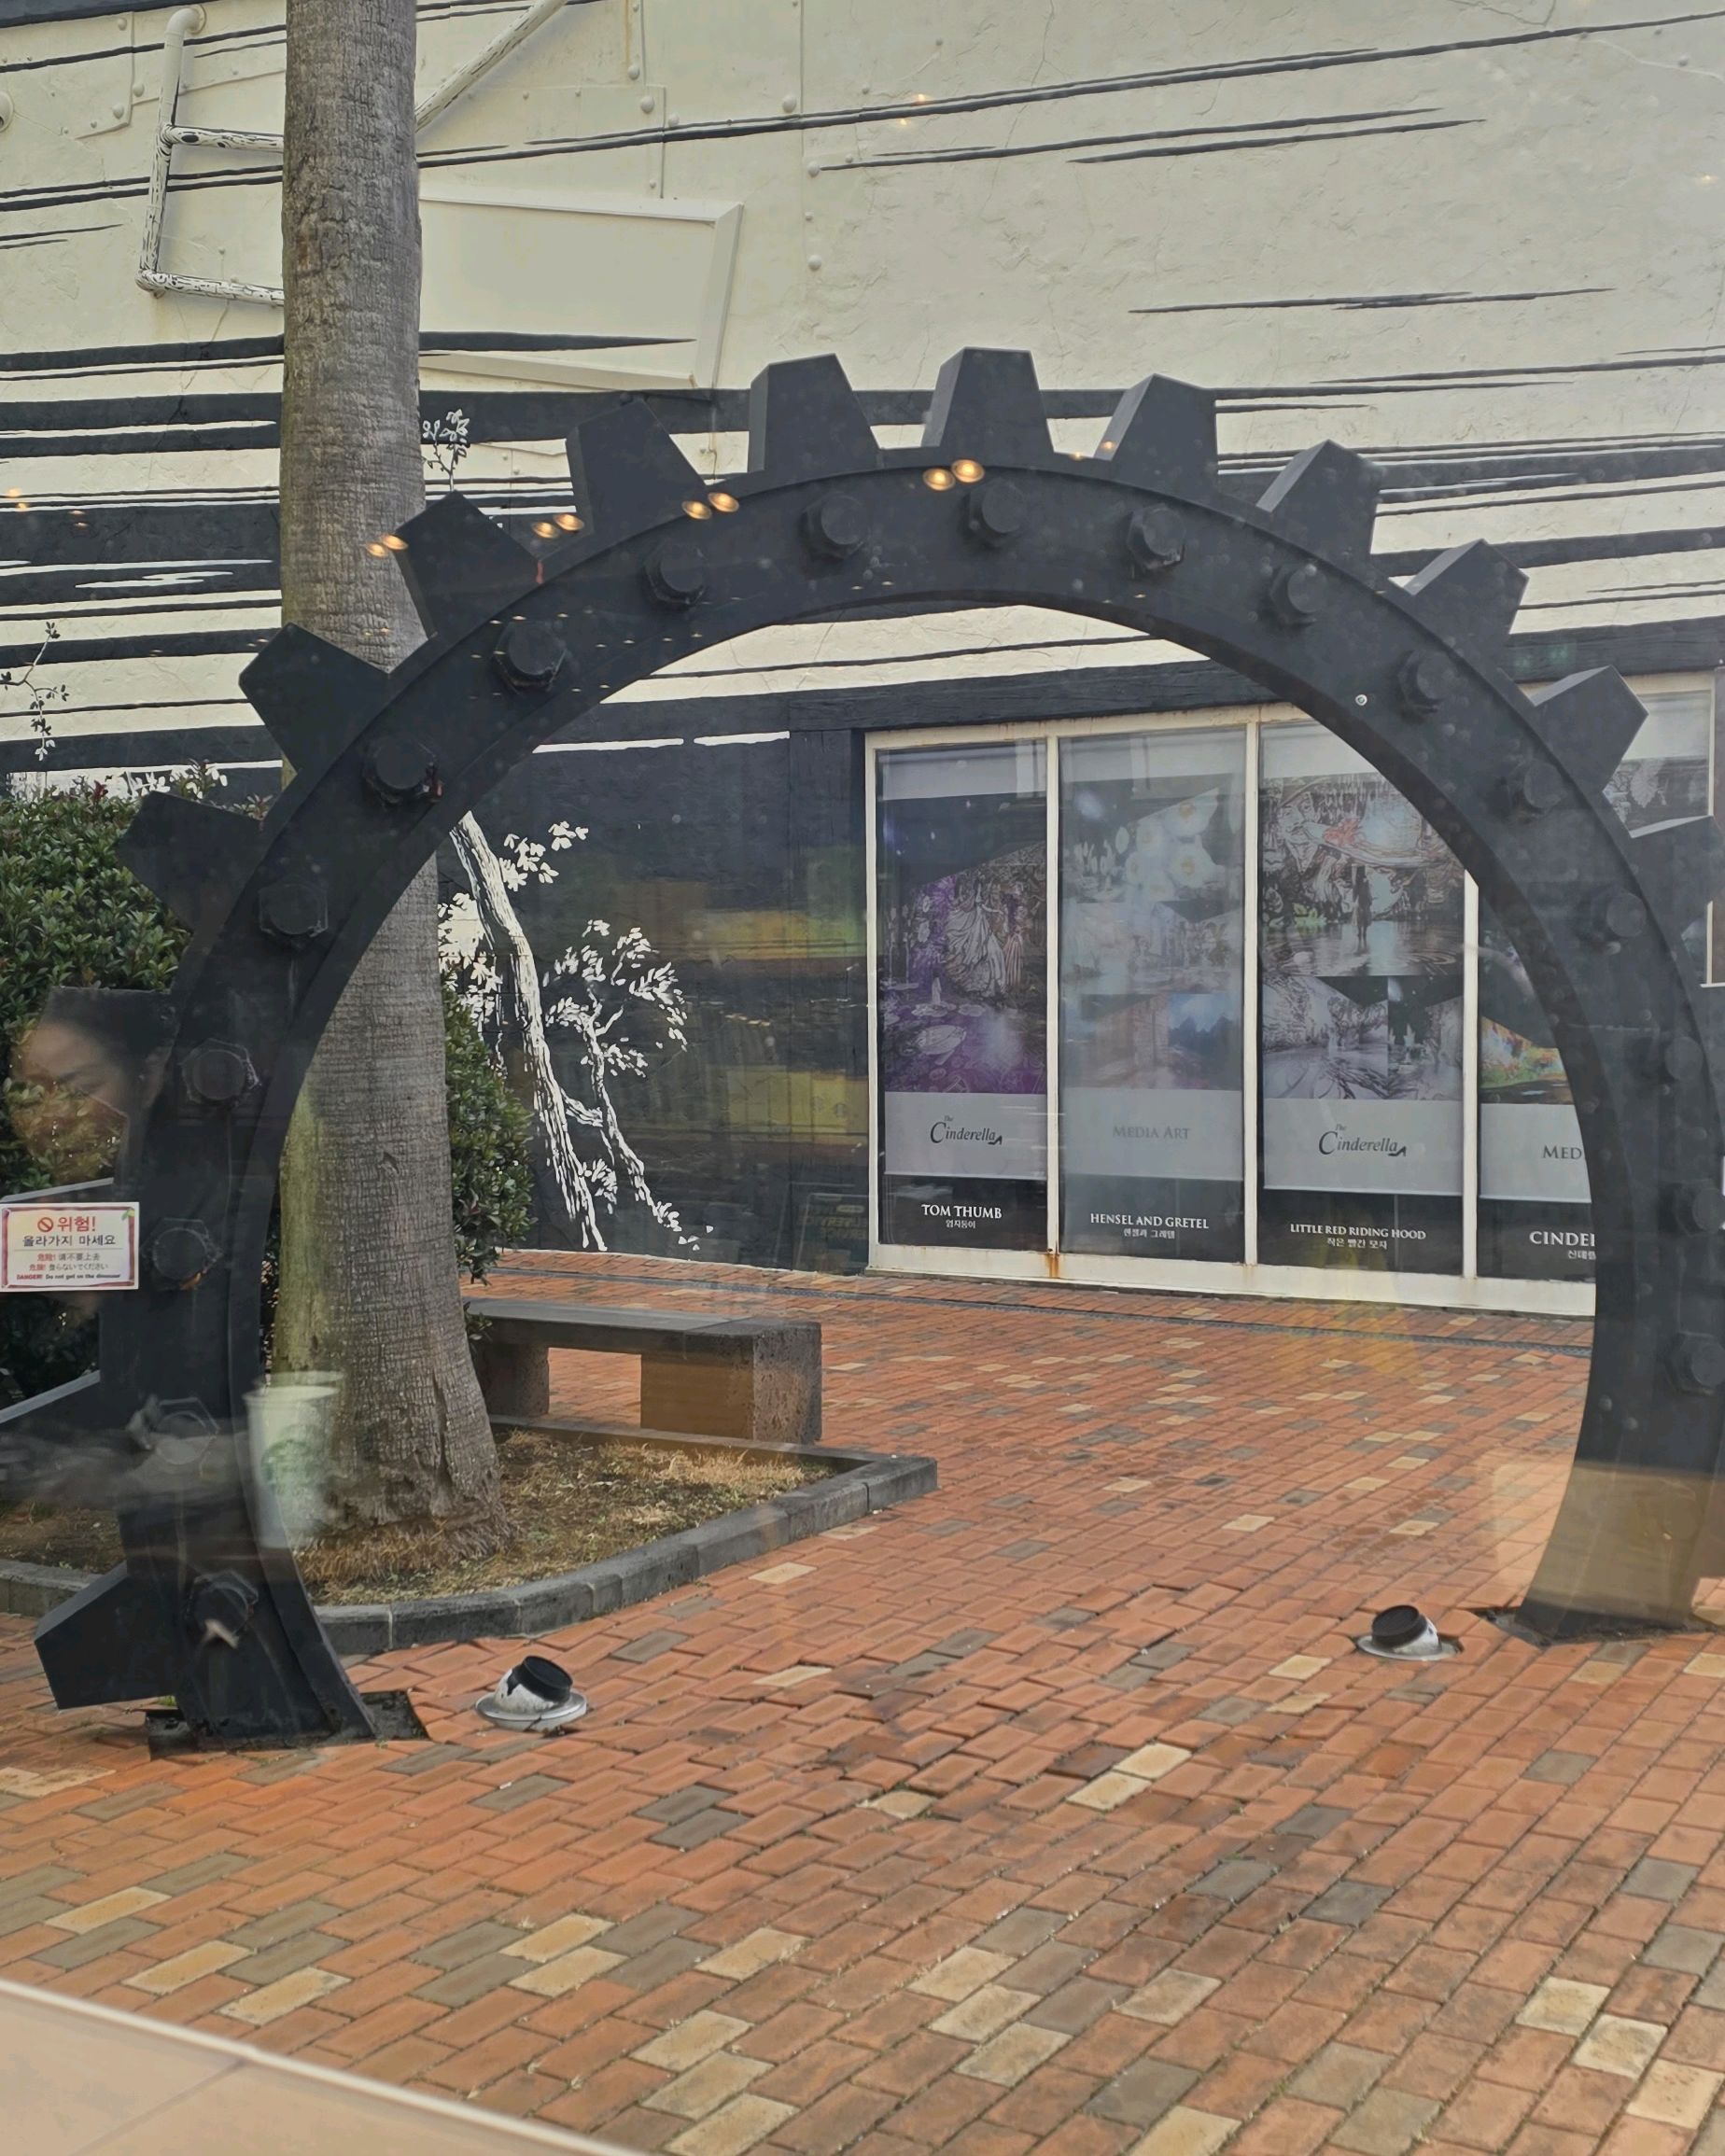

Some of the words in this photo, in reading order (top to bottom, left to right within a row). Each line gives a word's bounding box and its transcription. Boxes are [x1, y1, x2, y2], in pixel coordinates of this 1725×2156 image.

[931, 1121, 997, 1143] Cinderella
[1113, 1126, 1158, 1139] MEDIA
[1164, 1126, 1191, 1139] ART
[1319, 1130, 1398, 1155] Cinderella
[921, 1204, 951, 1217] TOM
[953, 1205, 1003, 1219] THUMB
[57, 1216, 96, 1232] 위험!
[1090, 1213, 1134, 1225] HENSEL
[1136, 1216, 1163, 1226] AND
[1165, 1217, 1210, 1229] GRETEL
[1290, 1224, 1324, 1234] LITTLE
[1325, 1225, 1347, 1235] RED
[1349, 1226, 1389, 1238] RIDING
[1391, 1229, 1427, 1239] HOOD
[22, 1235, 73, 1247] 올라가지
[78, 1235, 116, 1246] 마세요
